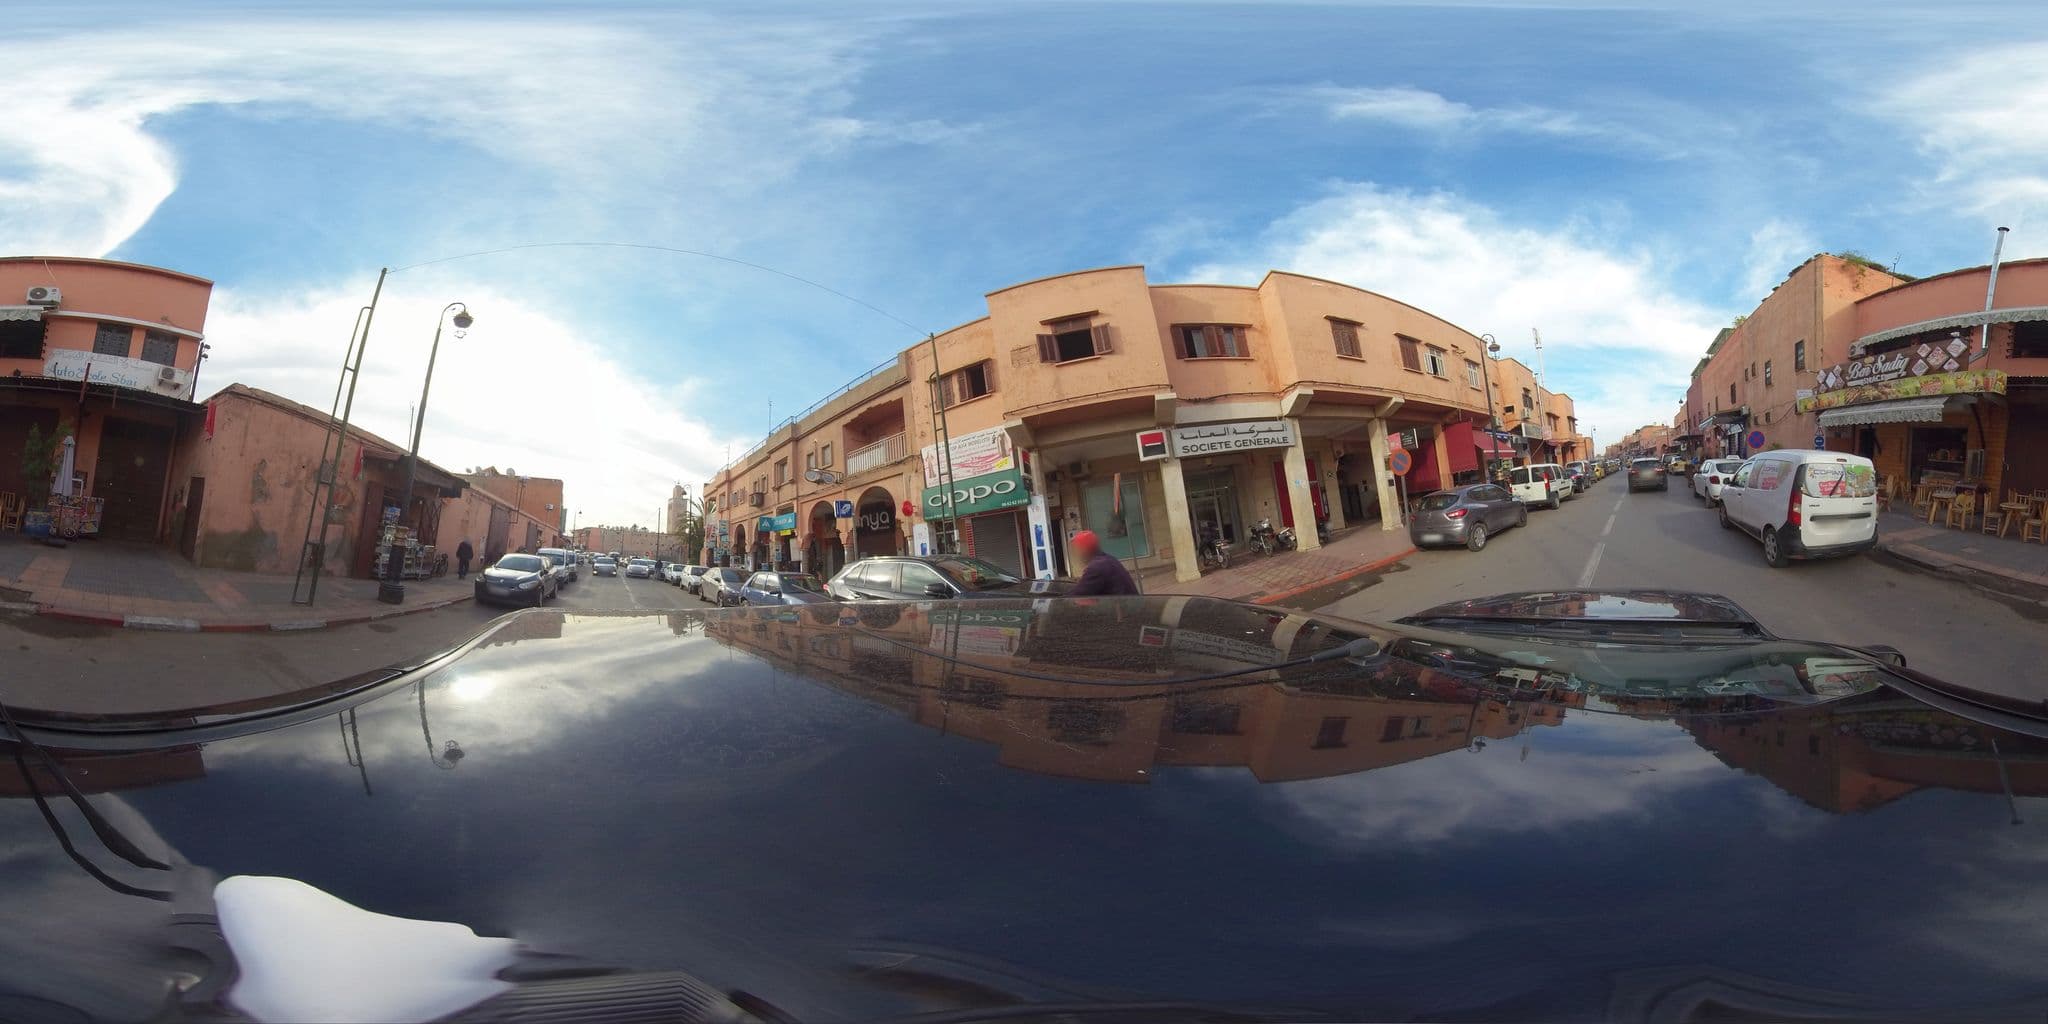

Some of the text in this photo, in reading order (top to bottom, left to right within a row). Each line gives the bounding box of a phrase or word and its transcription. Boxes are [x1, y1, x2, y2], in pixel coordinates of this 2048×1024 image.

[1844, 361, 1872, 379] Ben
[1180, 423, 1287, 440] الشركة العامة
[1182, 436, 1289, 454] SOCIETE GENERALE
[857, 511, 889, 530] nya
